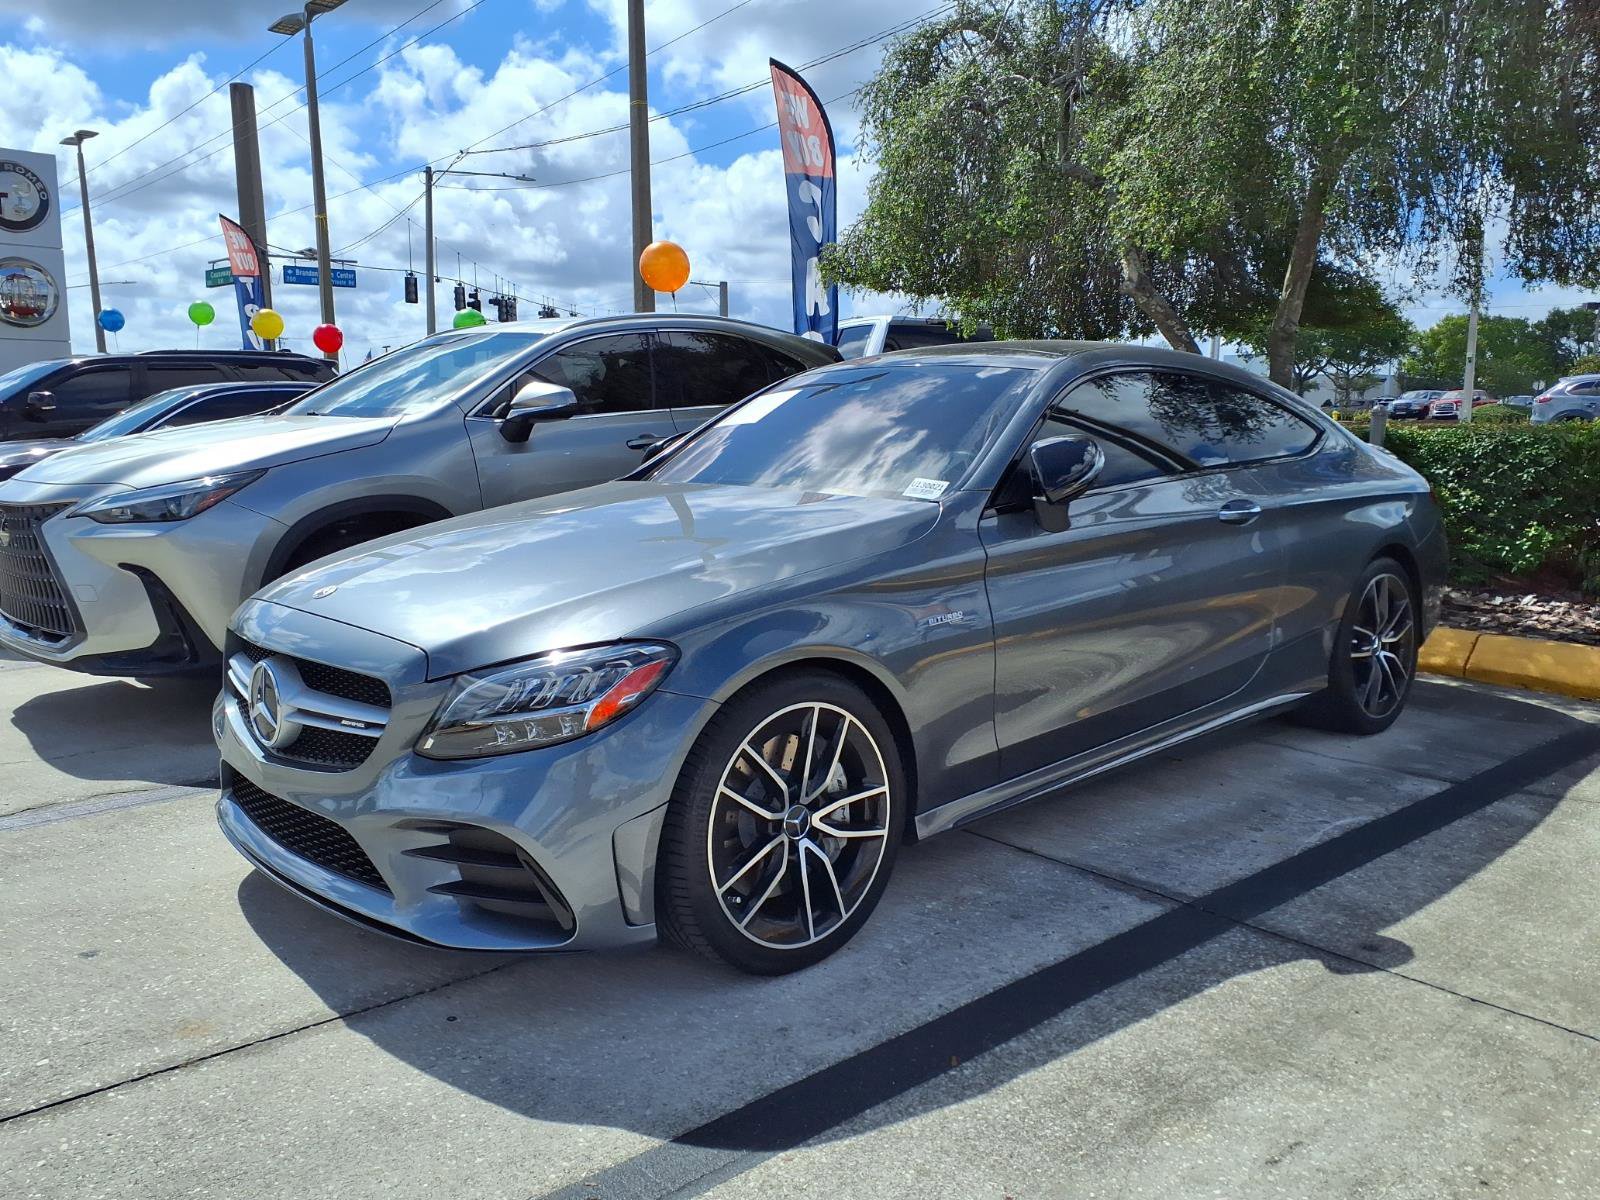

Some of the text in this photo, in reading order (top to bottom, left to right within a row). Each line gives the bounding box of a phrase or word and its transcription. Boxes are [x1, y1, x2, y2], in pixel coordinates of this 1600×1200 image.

[4, 163, 48, 200] ROMEO
[336, 271, 354, 280] Center
[928, 610, 964, 625] BITURBO
